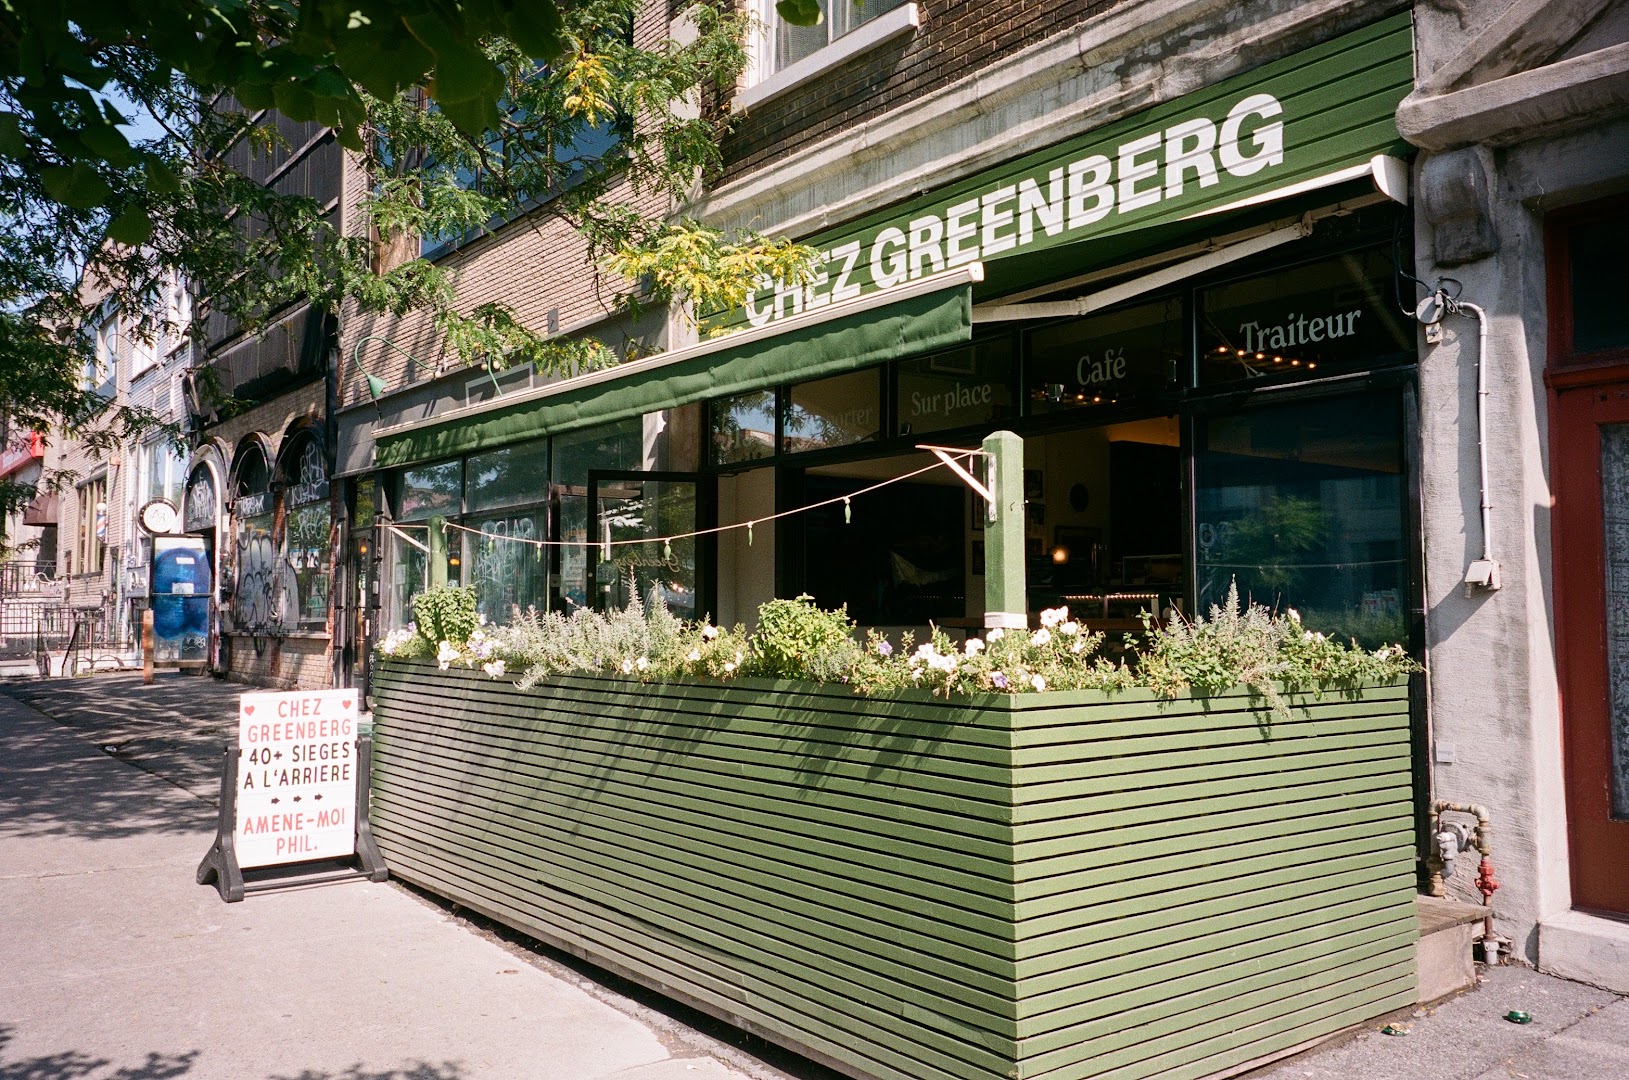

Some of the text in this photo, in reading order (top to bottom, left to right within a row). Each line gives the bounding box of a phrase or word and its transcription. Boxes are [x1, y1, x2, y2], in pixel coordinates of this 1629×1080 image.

[745, 93, 1284, 327] CHEZ GREENBERG
[1239, 310, 1361, 354] Traiteur
[1077, 346, 1126, 385] Café
[911, 381, 992, 416] Sur place
[278, 698, 322, 718] CHEZ
[248, 719, 351, 743] GREENBERG
[249, 741, 350, 766] 40+ SIEGES
[244, 763, 350, 790] A L'ARRIERE
[243, 808, 345, 836] AMENE-MOI
[276, 835, 318, 856] PHIL.
